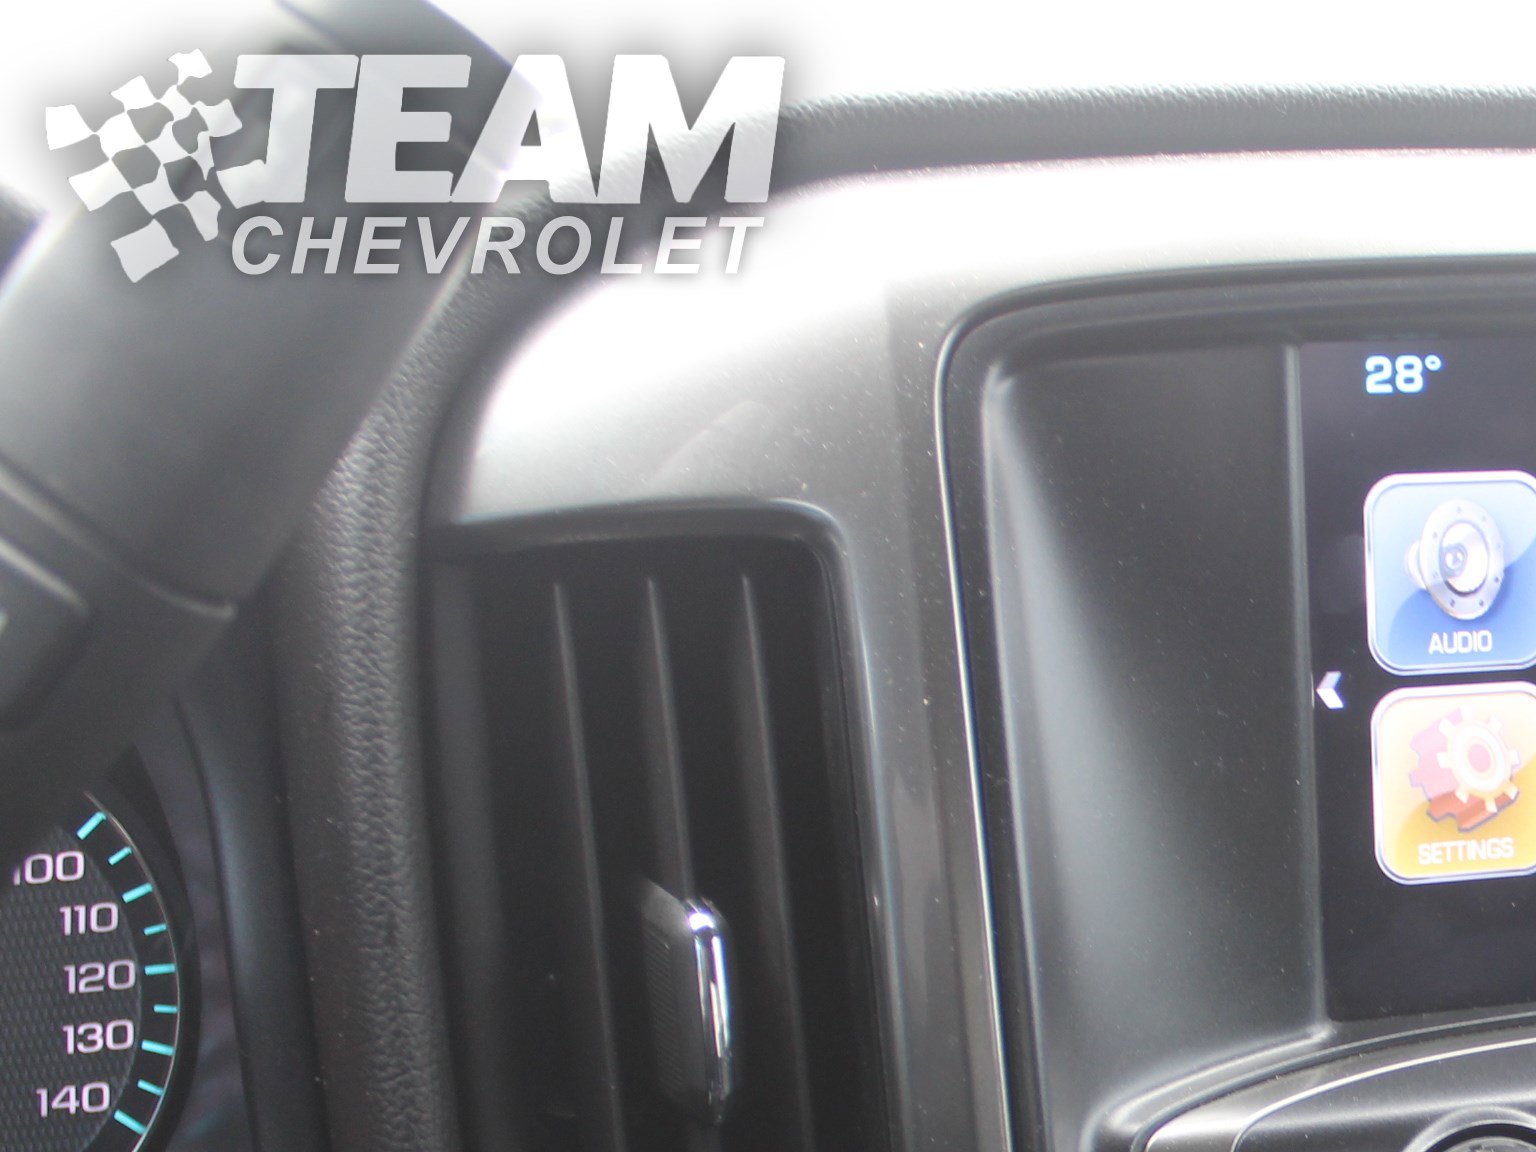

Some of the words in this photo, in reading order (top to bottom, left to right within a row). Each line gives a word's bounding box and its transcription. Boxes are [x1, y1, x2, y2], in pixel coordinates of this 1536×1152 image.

[1428, 630, 1493, 655] AUDIO
[1417, 837, 1515, 866] SETTINGS
[60, 902, 119, 936] 110
[64, 959, 137, 994] 120
[62, 1019, 135, 1055] 130
[36, 1081, 111, 1118] 140
